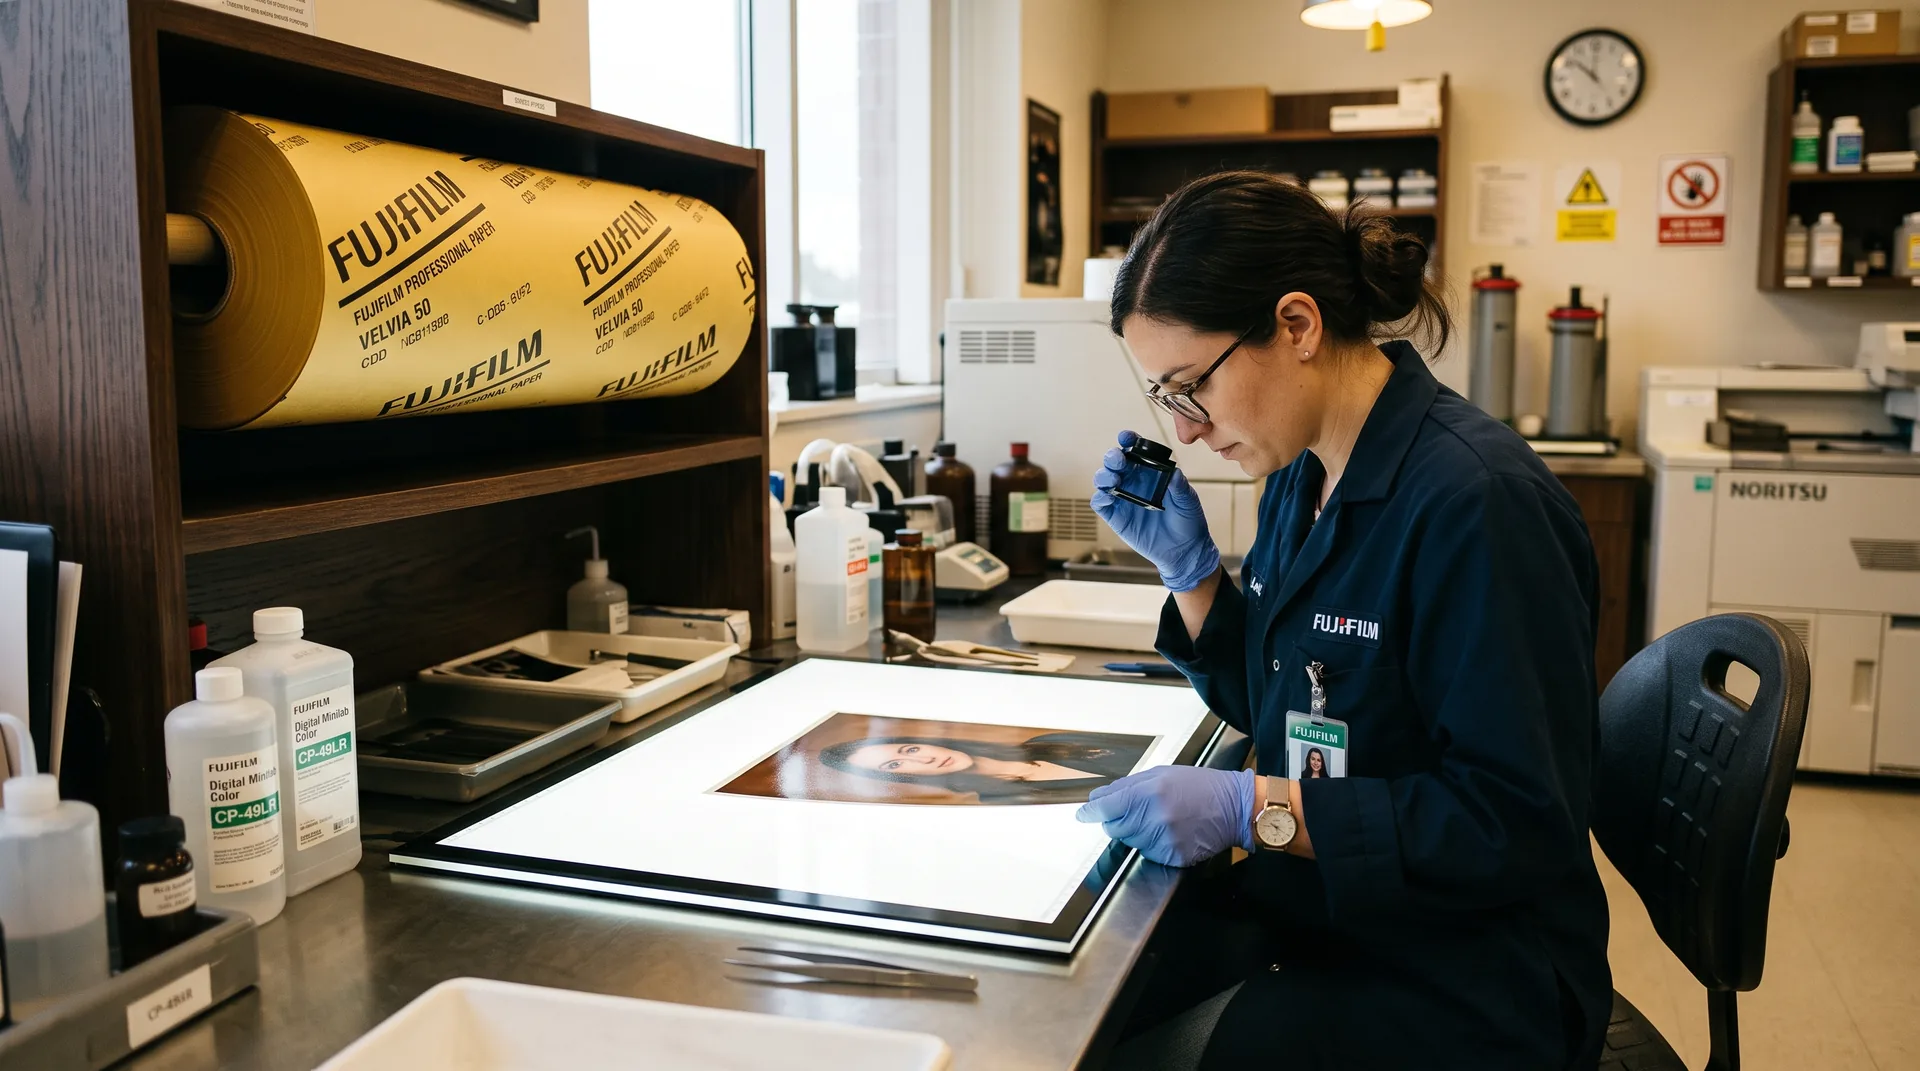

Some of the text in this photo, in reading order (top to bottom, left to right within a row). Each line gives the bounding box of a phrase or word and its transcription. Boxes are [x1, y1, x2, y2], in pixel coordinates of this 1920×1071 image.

[328, 170, 466, 284] FUJIFILM
[574, 200, 658, 287] FUJIFILM
[353, 220, 496, 326] FUJIFILM PROFESSIONAL PAPER
[592, 288, 625, 320] FUJIFILM
[624, 254, 667, 296] PROFESSIONAL
[359, 297, 432, 350] VELVIA 50
[595, 297, 644, 340] VELVIA 50
[361, 348, 387, 369] CDD
[595, 338, 614, 355] CDD
[376, 329, 542, 416] FUJIFILM
[595, 324, 716, 398] FUJIFILM
[510, 371, 543, 392] PAPER
[1730, 481, 1828, 502] NORITSU
[1313, 613, 1379, 640] FUJIFILM
[293, 697, 330, 715] FUJIFILM
[294, 706, 349, 732] Digital Minilab
[295, 728, 318, 743] Color
[1295, 726, 1338, 744] FUJIFILM
[298, 737, 347, 765] CP-49LR
[208, 757, 258, 772] FUJIFILM
[209, 777, 245, 791] Digital
[210, 791, 240, 802] Color
[214, 797, 277, 824] CP-49LR
